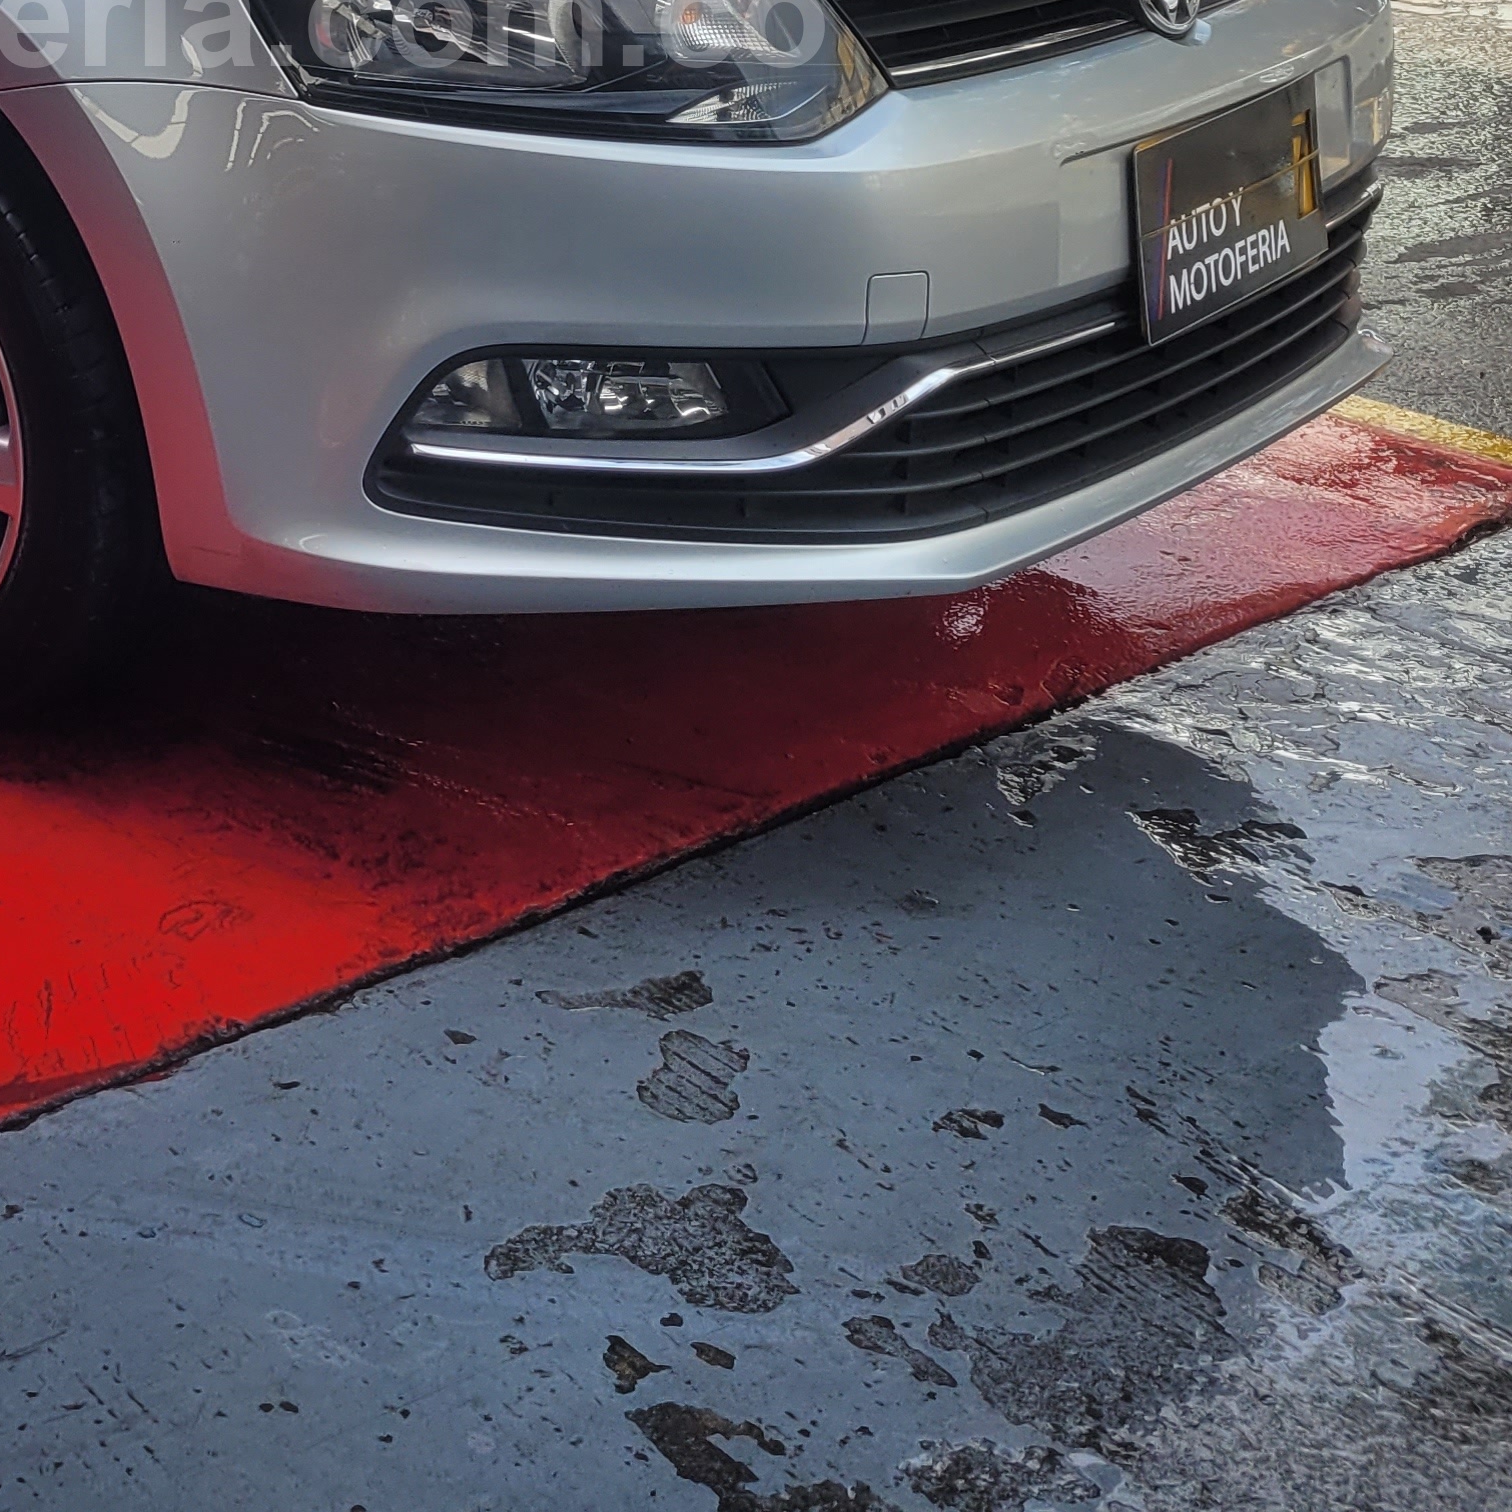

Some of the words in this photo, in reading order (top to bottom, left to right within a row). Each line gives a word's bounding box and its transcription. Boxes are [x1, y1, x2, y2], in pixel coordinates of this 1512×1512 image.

[1167, 194, 1226, 261] AUTO
[1226, 187, 1244, 228] Y
[1168, 218, 1291, 314] MOTOFERIA
